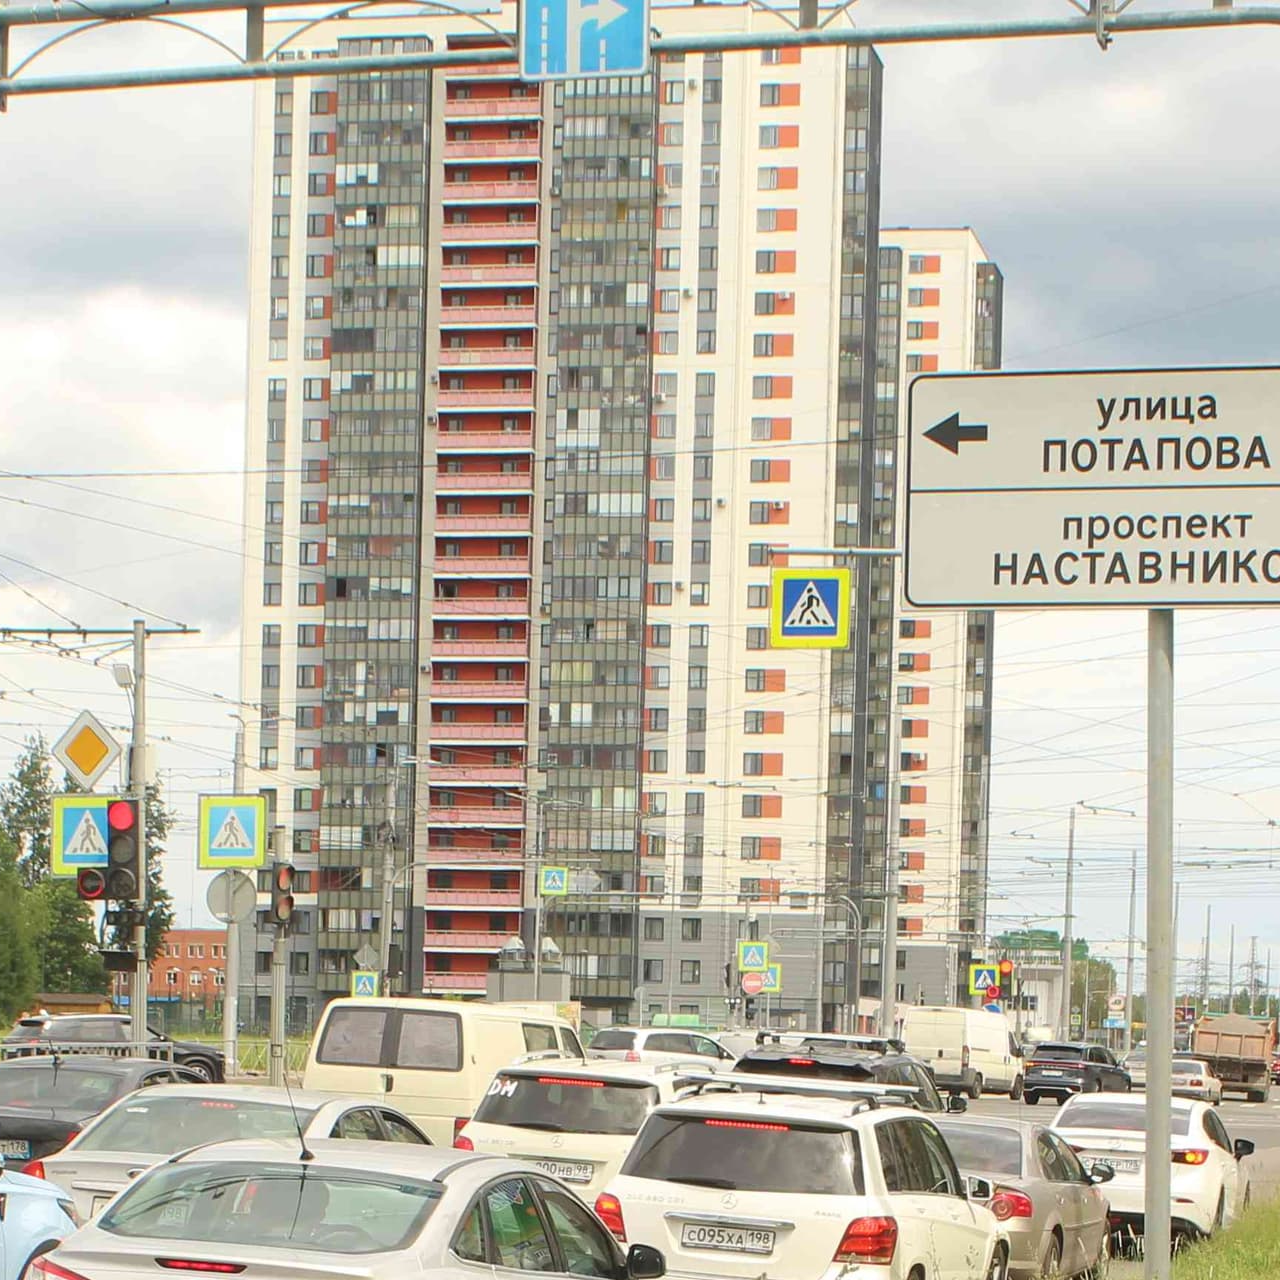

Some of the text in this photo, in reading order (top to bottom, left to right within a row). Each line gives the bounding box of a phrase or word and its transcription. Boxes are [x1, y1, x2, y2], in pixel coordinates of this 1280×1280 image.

[1096, 394, 1218, 430] улица
[1042, 435, 1272, 473] ПОТАПОВА
[1062, 512, 1254, 549] проспект
[9, 1141, 26, 1151] 178
[686, 1226, 770, 1246] С095ХА 198
